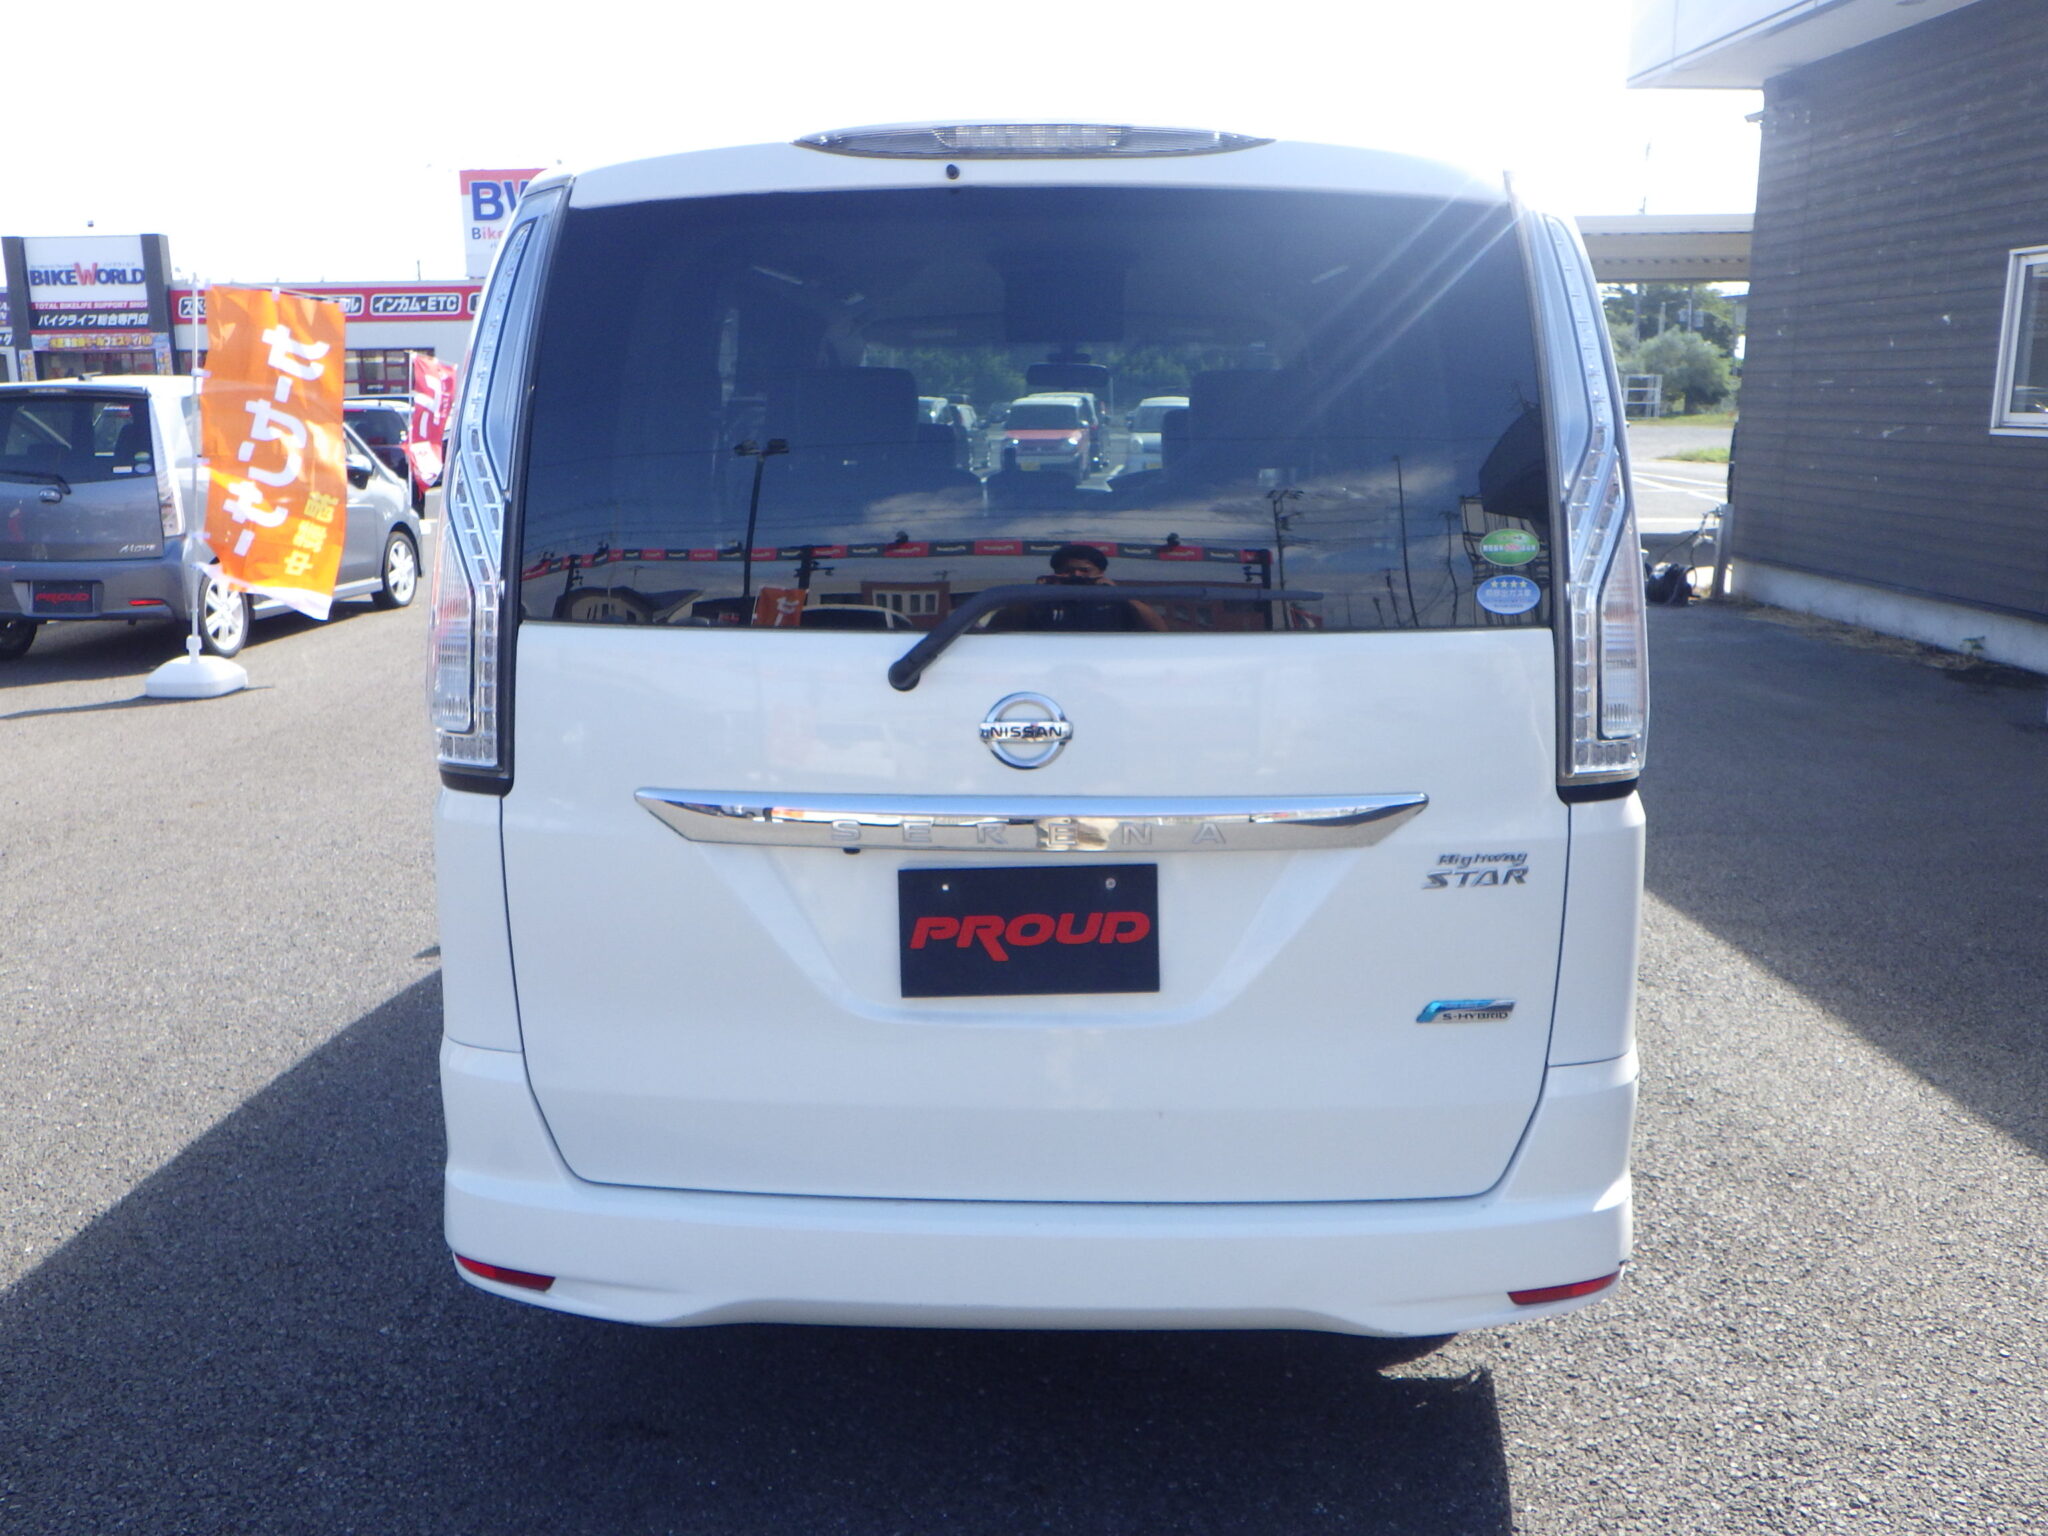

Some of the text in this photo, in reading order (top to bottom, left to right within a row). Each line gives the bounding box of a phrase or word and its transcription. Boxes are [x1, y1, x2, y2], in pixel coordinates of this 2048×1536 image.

[35, 302, 57, 310] TOTAL
[94, 301, 128, 309] SUPPORT
[38, 313, 149, 326] バイクライフ総合専門店
[990, 726, 1062, 738] NISSAN
[830, 818, 1227, 848] SERENA
[1437, 852, 1528, 869] Highway
[1422, 866, 1529, 889] STAR
[909, 911, 1151, 962] PROUD
[1442, 1012, 1509, 1021] S-HYBRID
